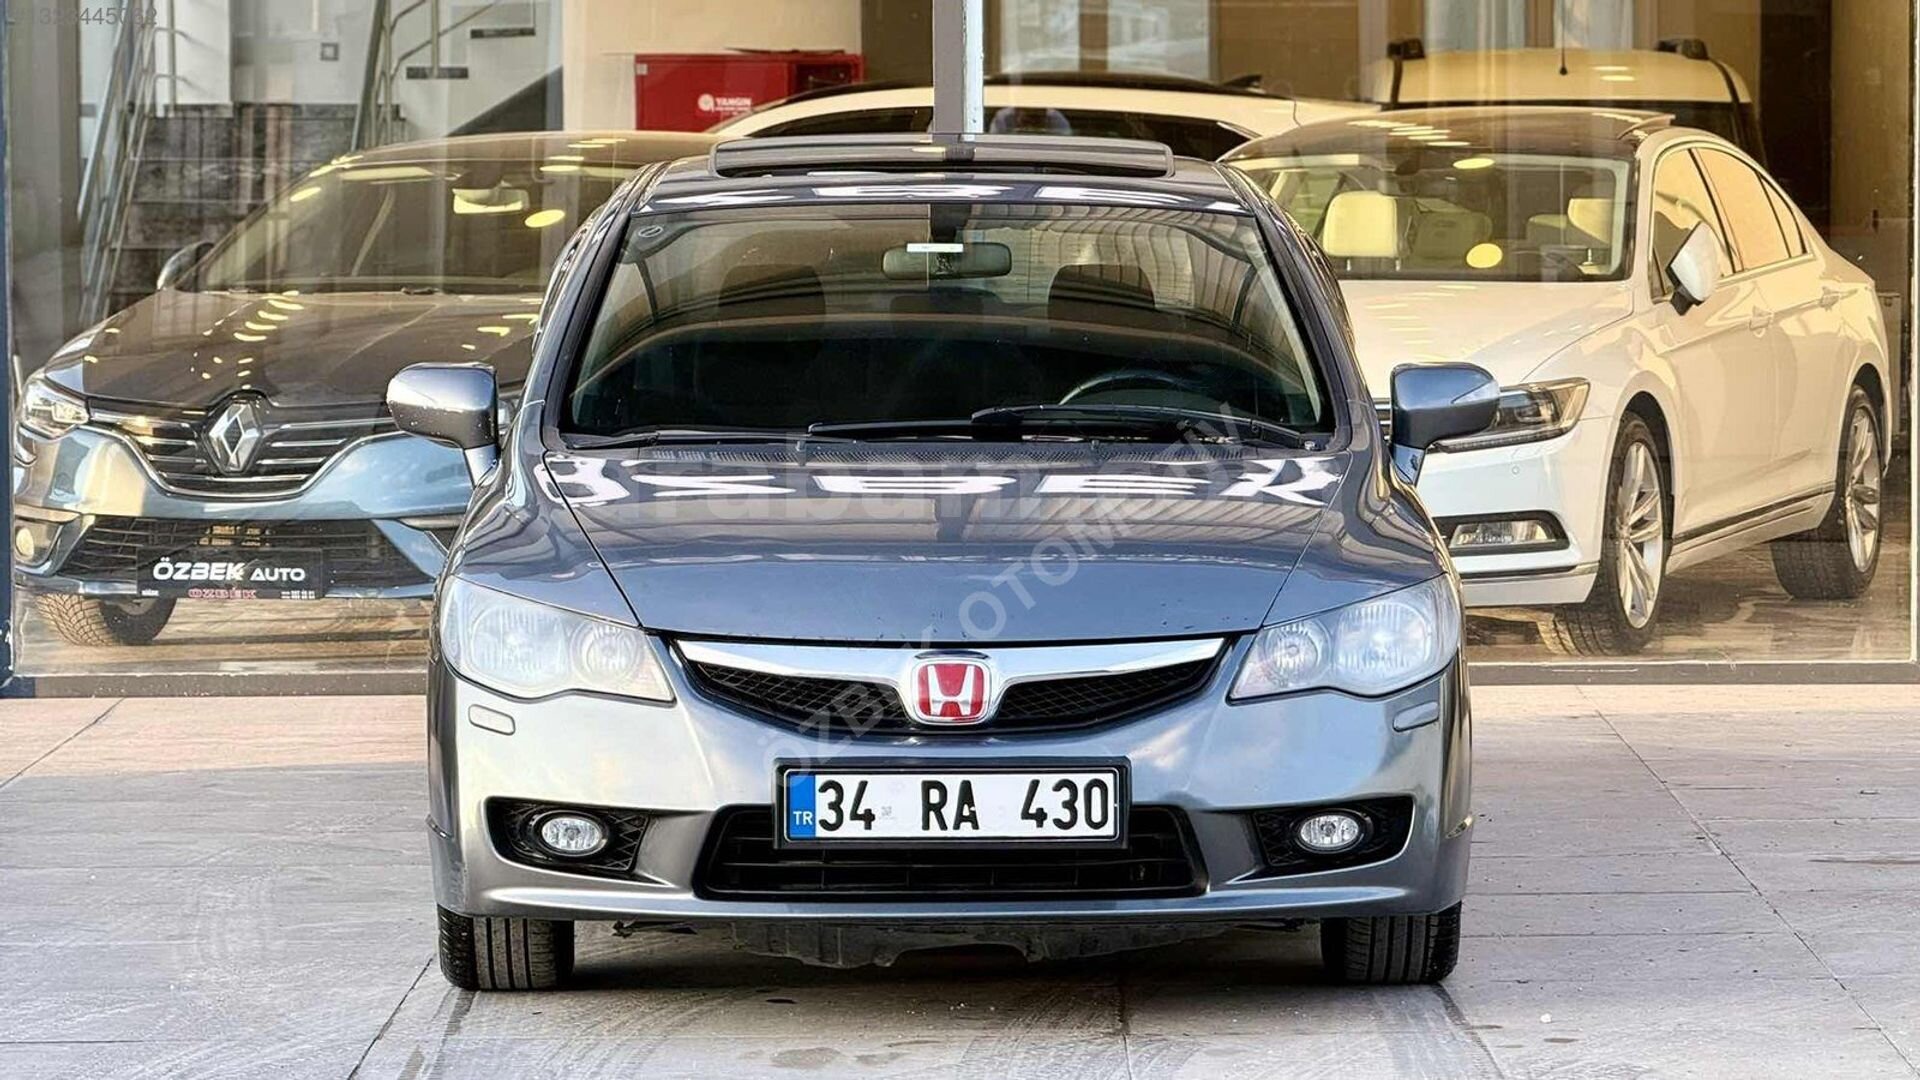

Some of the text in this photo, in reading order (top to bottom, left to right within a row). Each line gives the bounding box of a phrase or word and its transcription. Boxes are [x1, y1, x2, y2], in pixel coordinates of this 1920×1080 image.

[153, 557, 306, 582] ÖZBEK AUTO
[793, 778, 1109, 832] TR 34 RA 430
